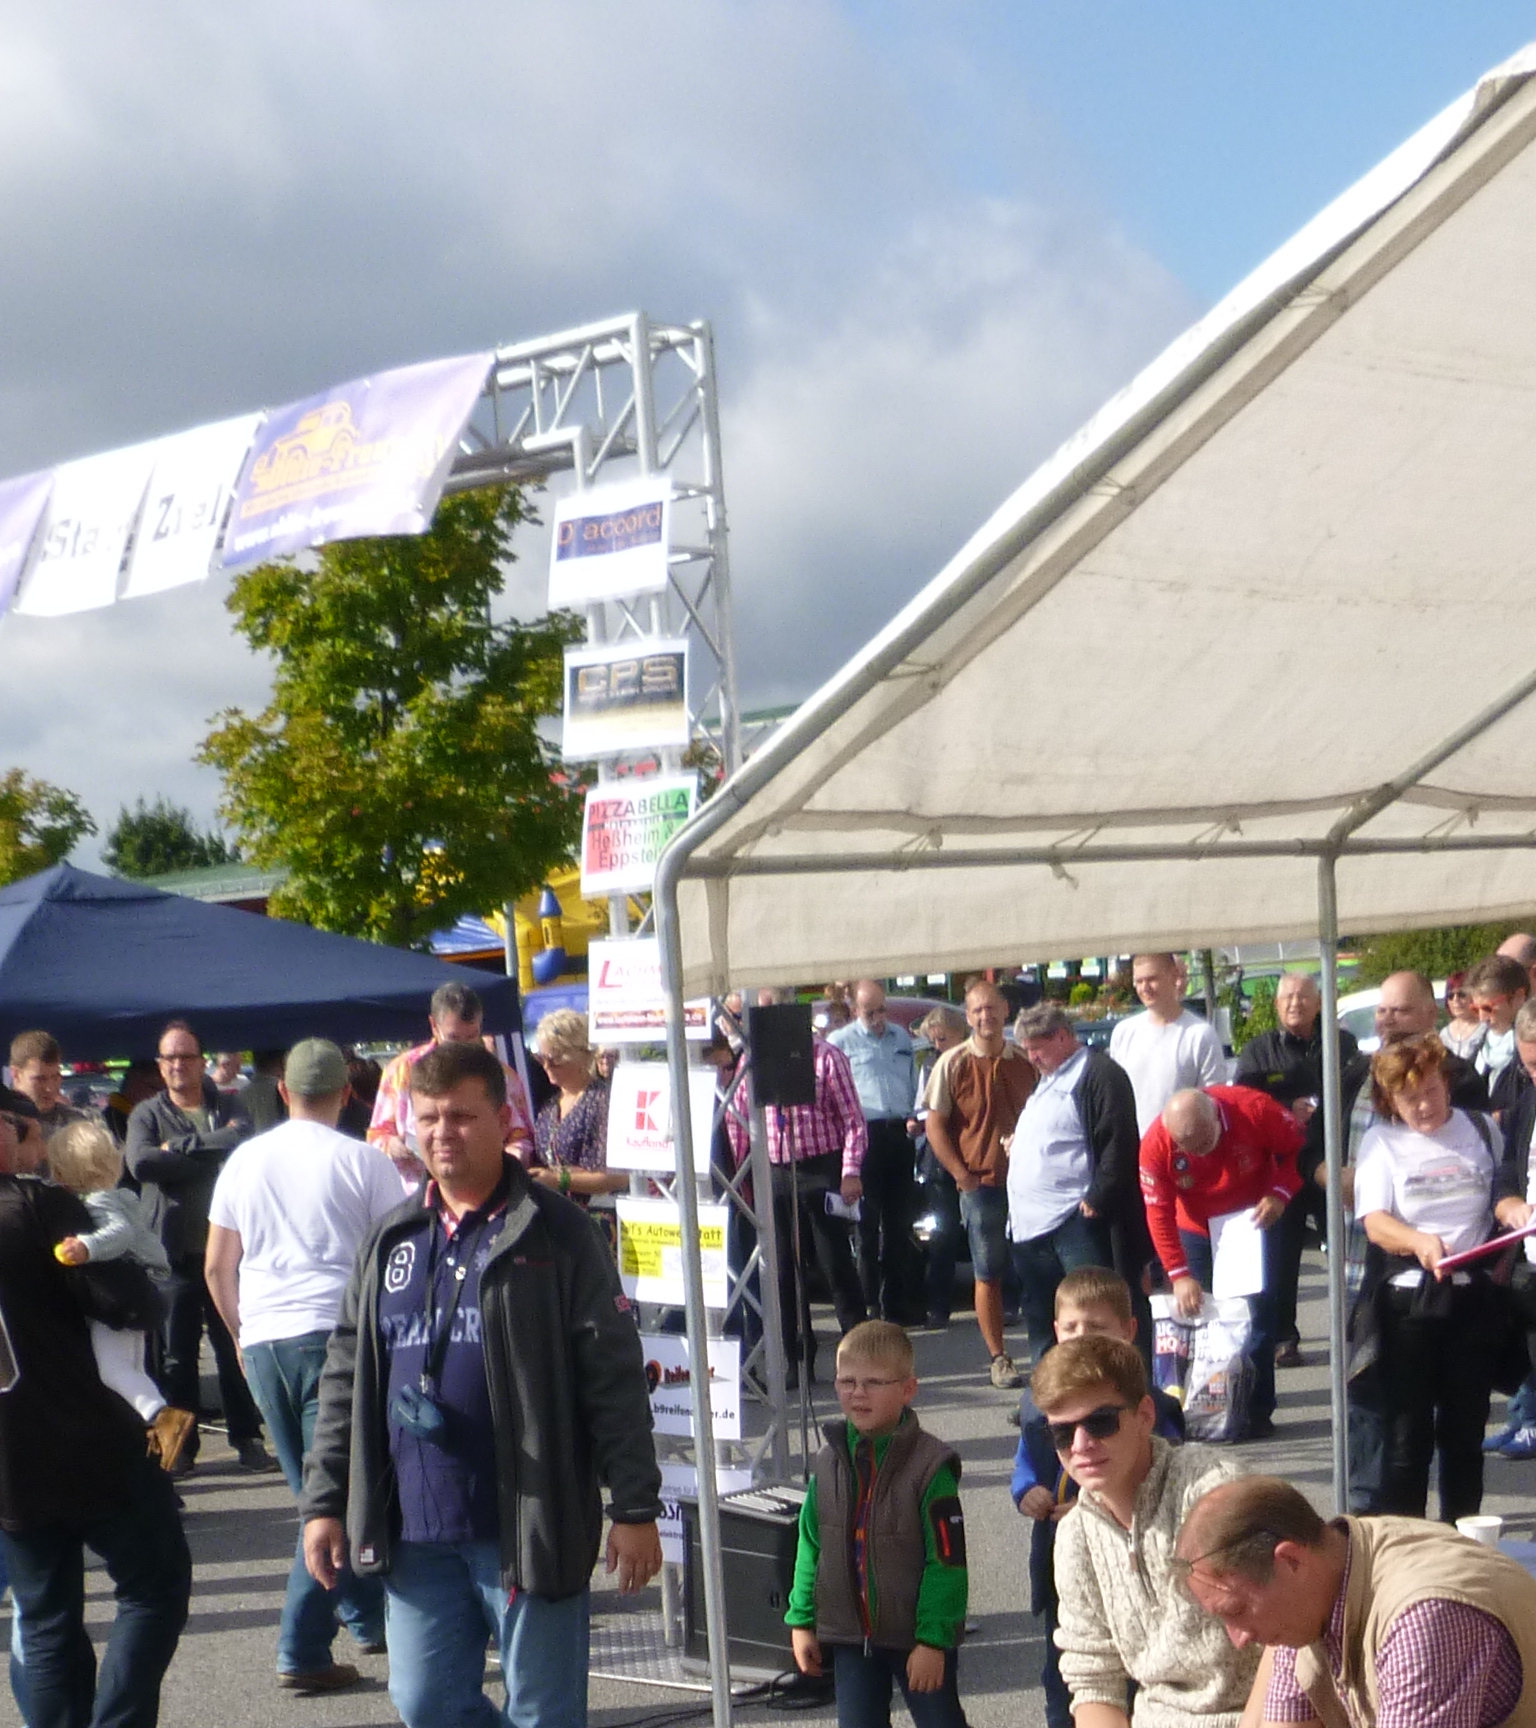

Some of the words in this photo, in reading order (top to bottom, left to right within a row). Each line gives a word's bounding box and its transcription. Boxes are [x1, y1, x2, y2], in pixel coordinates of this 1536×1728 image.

[598, 846, 663, 872] Eppstei
[626, 1135, 672, 1150] Kaufland
[385, 1241, 416, 1294] 8
